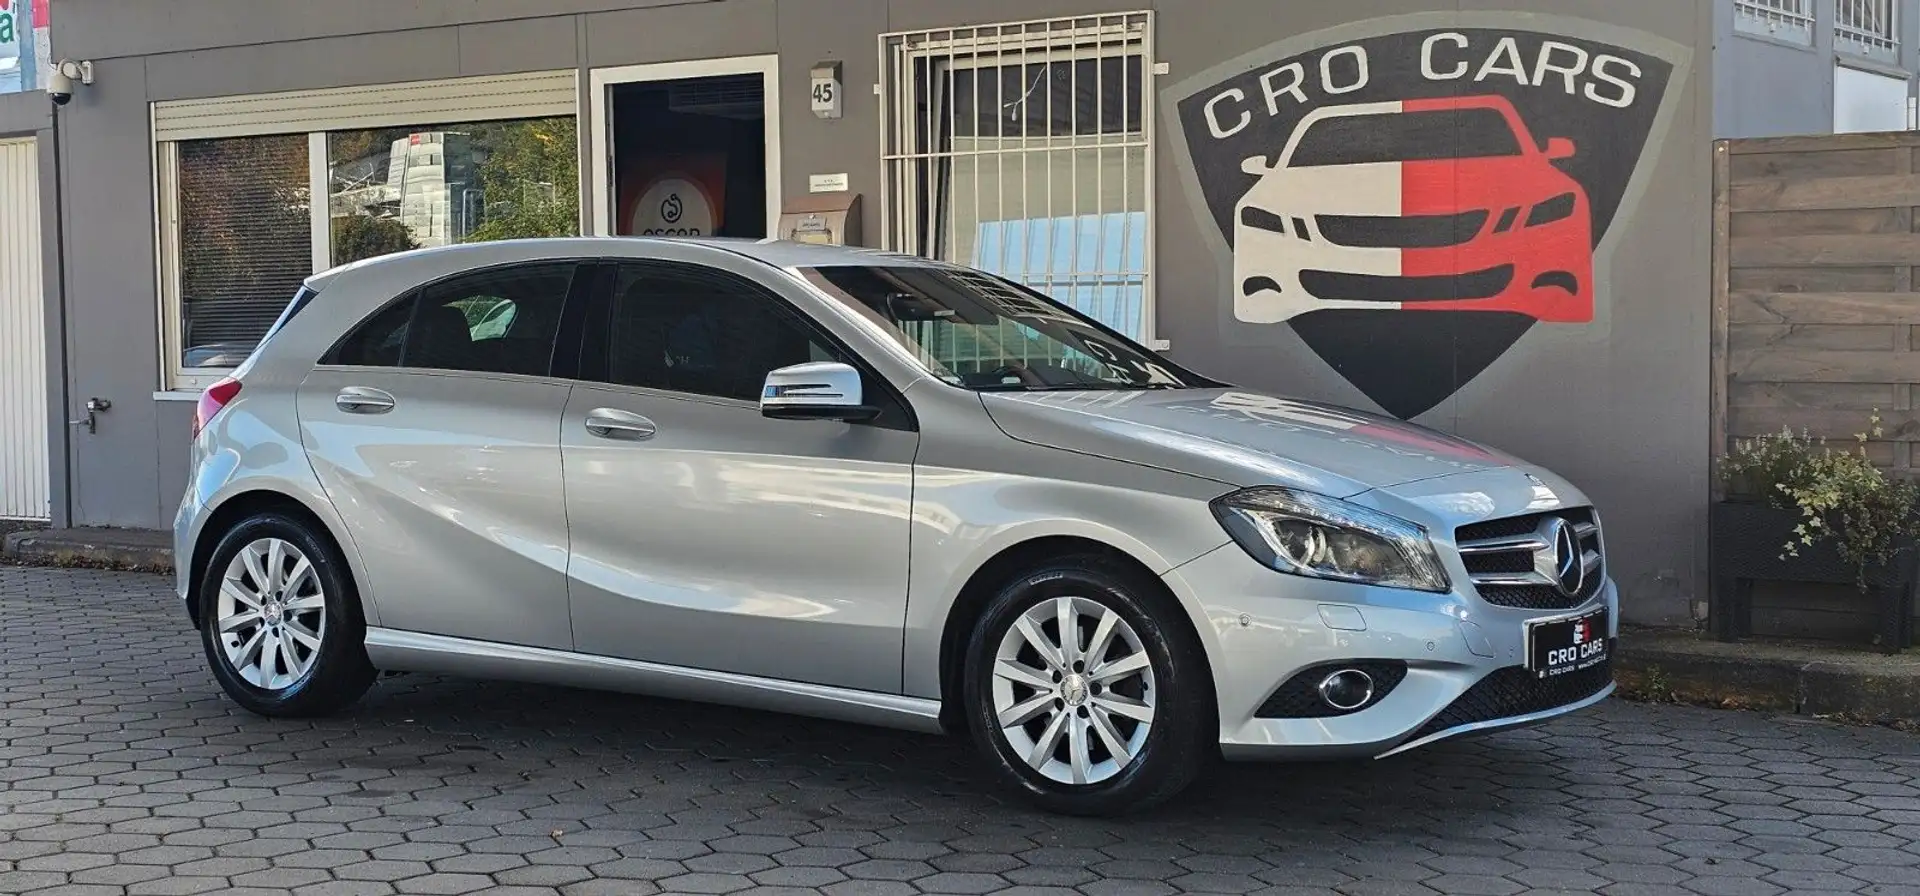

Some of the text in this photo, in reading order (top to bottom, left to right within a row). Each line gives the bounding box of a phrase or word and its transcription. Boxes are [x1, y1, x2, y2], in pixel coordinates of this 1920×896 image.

[812, 83, 833, 103] 45
[1204, 32, 1642, 140] CRO CARS
[1548, 646, 1577, 666] CRO
[1580, 637, 1603, 659] CARS
